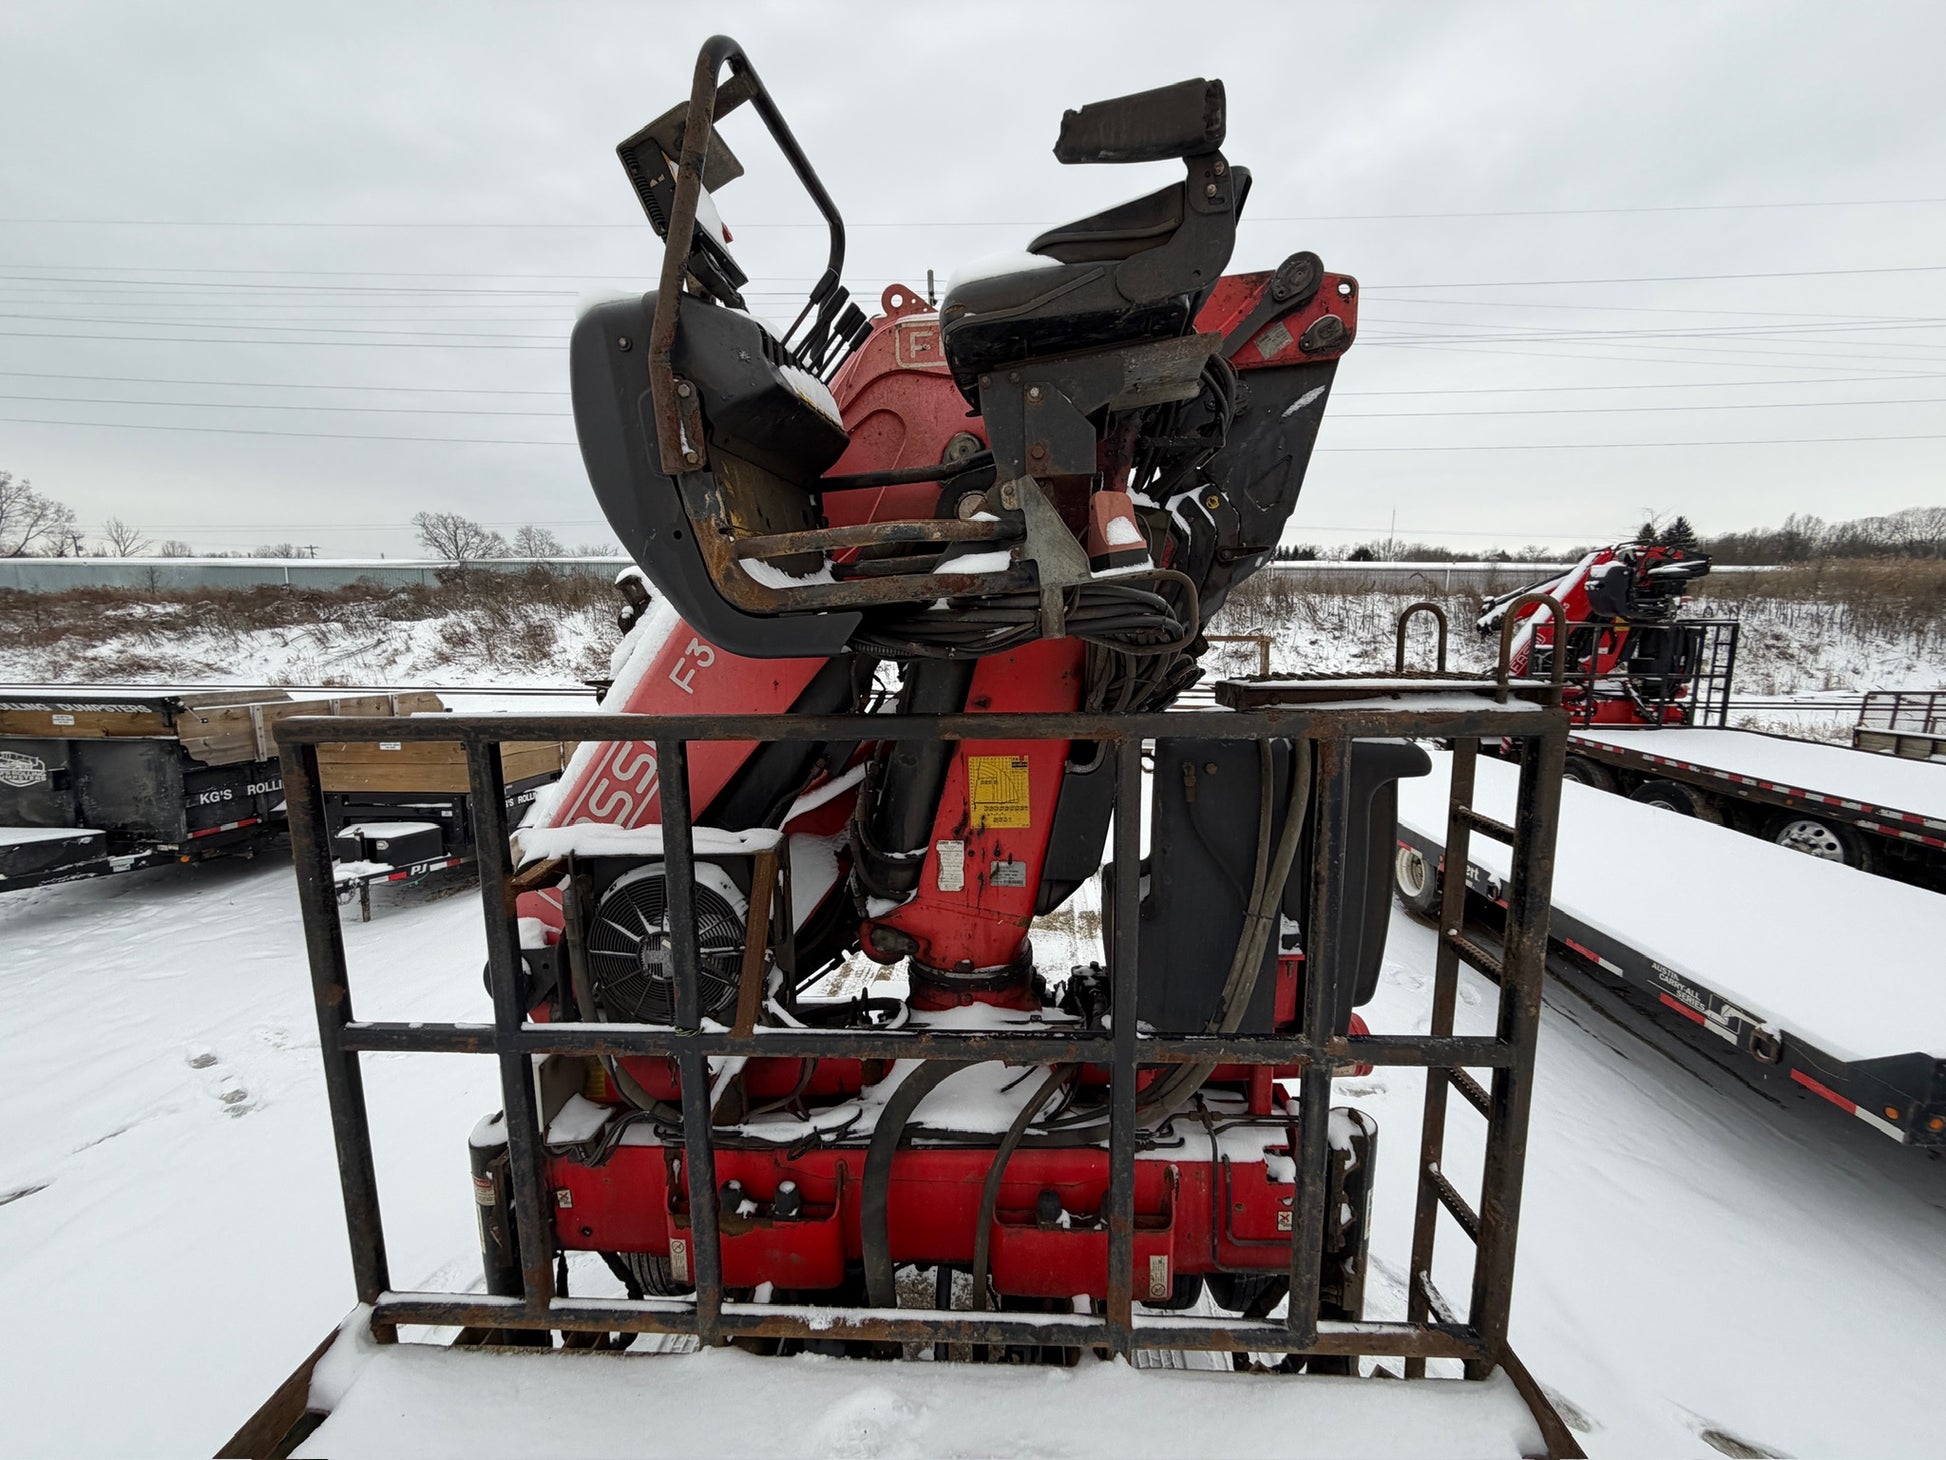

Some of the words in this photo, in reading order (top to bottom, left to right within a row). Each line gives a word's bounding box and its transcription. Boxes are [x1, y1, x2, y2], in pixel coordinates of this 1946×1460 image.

[57, 703, 153, 714] DUMPSTERS
[200, 788, 233, 805] KG'S
[410, 863, 428, 877] PJ
[1659, 973, 1702, 1001] CARRY-ALL
[1676, 989, 1706, 1012] SERIES
